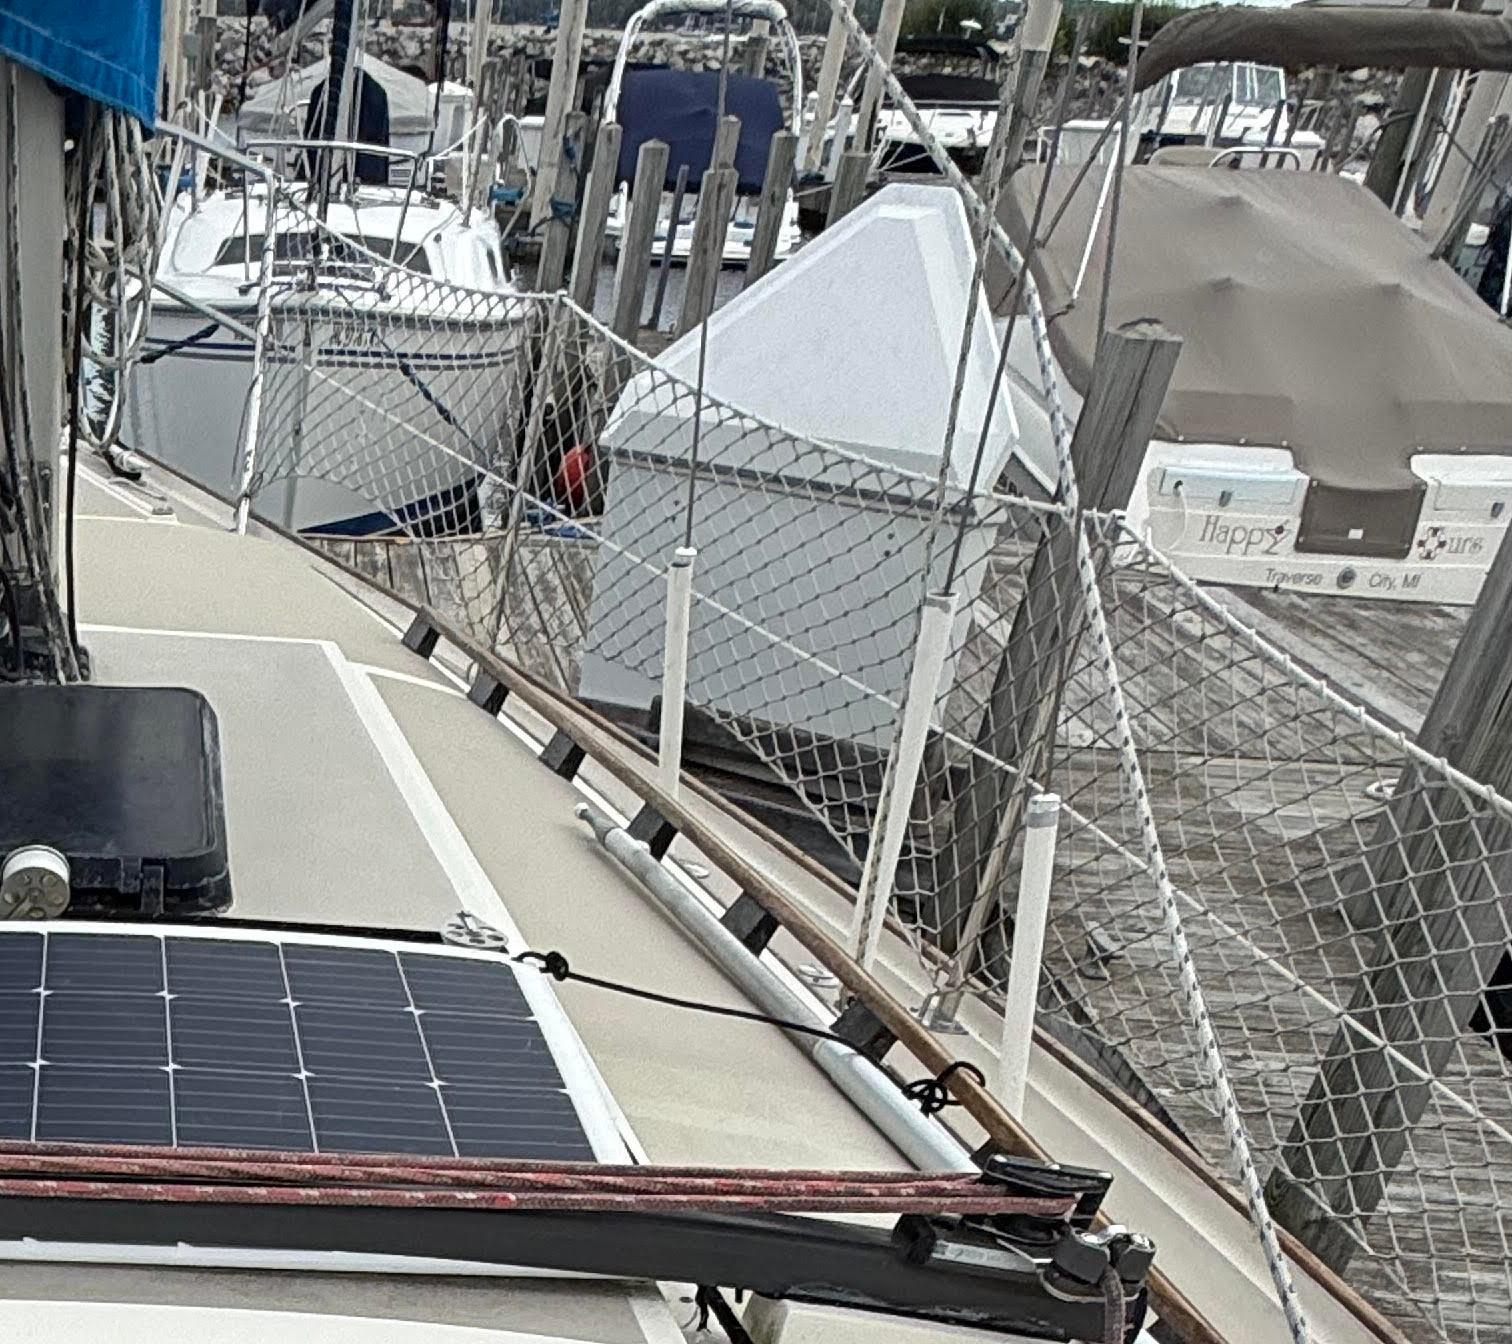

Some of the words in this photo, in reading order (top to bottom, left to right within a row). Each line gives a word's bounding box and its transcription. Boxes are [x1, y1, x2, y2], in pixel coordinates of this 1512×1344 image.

[1199, 514, 1293, 556] Happy
[1266, 567, 1324, 586] Traverse
[1369, 573, 1396, 591] City,
[1401, 573, 1421, 589] MI
